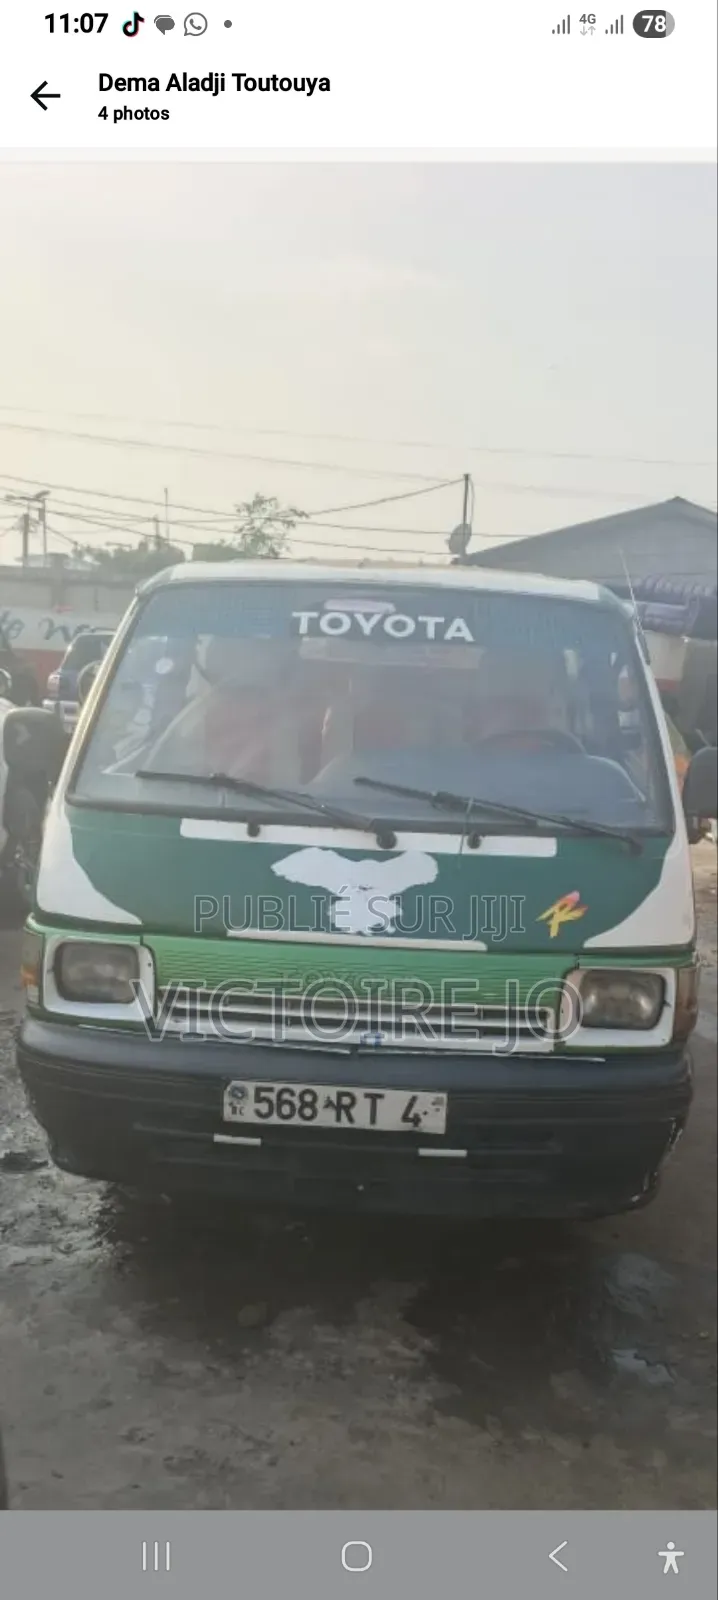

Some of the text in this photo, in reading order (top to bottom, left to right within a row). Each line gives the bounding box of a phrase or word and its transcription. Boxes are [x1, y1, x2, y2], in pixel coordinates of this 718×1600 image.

[44, 13, 109, 34] 11:07
[579, 13, 597, 25] 4G
[641, 14, 667, 33] 78
[98, 72, 331, 97] Dema Aladji Toutouya
[98, 105, 170, 124] 4 photos
[292, 611, 475, 642] TOYOTA
[253, 1086, 319, 1121] 568
